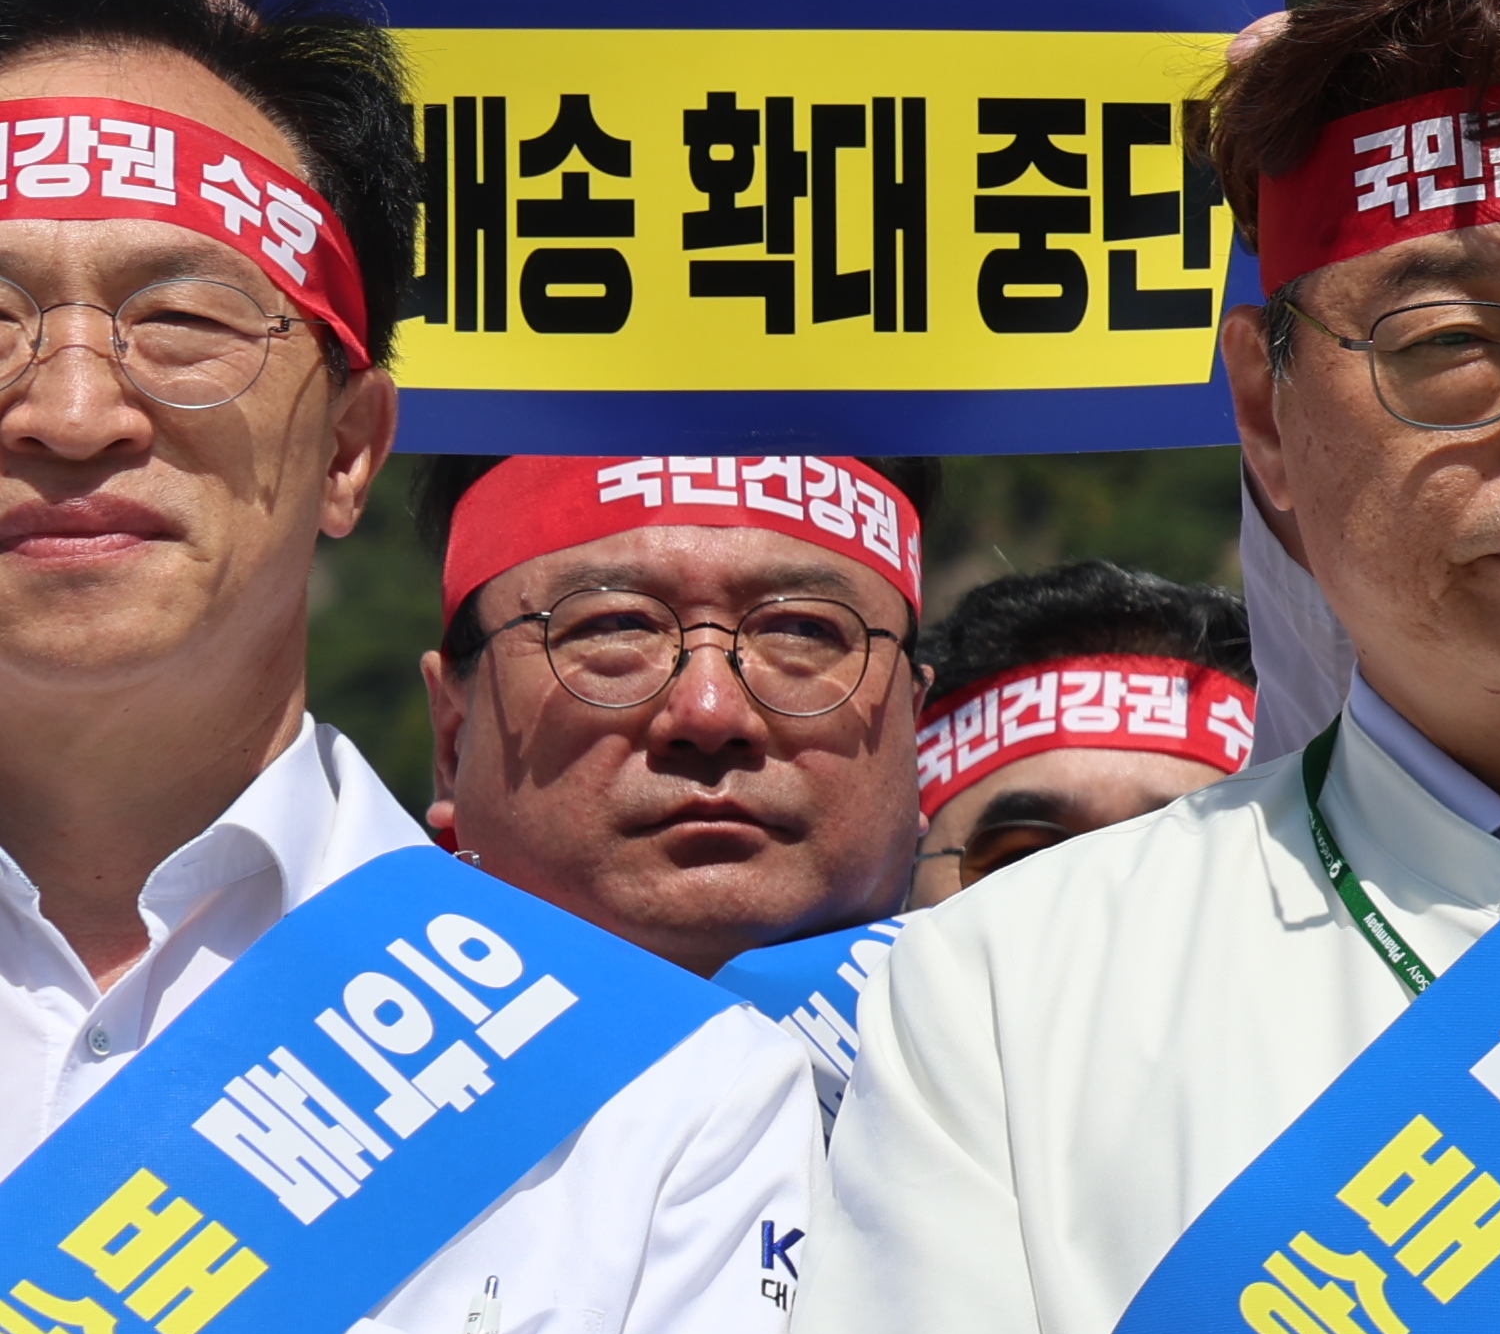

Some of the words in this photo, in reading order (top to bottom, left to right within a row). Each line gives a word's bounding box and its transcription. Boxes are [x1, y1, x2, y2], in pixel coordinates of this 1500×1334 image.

[0, 115, 177, 206] 강권
[200, 154, 324, 287] 수호
[681, 91, 928, 336] 확대
[973, 97, 1223, 334] 중단
[915, 670, 1189, 790] 국민건강권
[1207, 693, 1256, 762] 수
[191, 913, 580, 1226] 의약품
